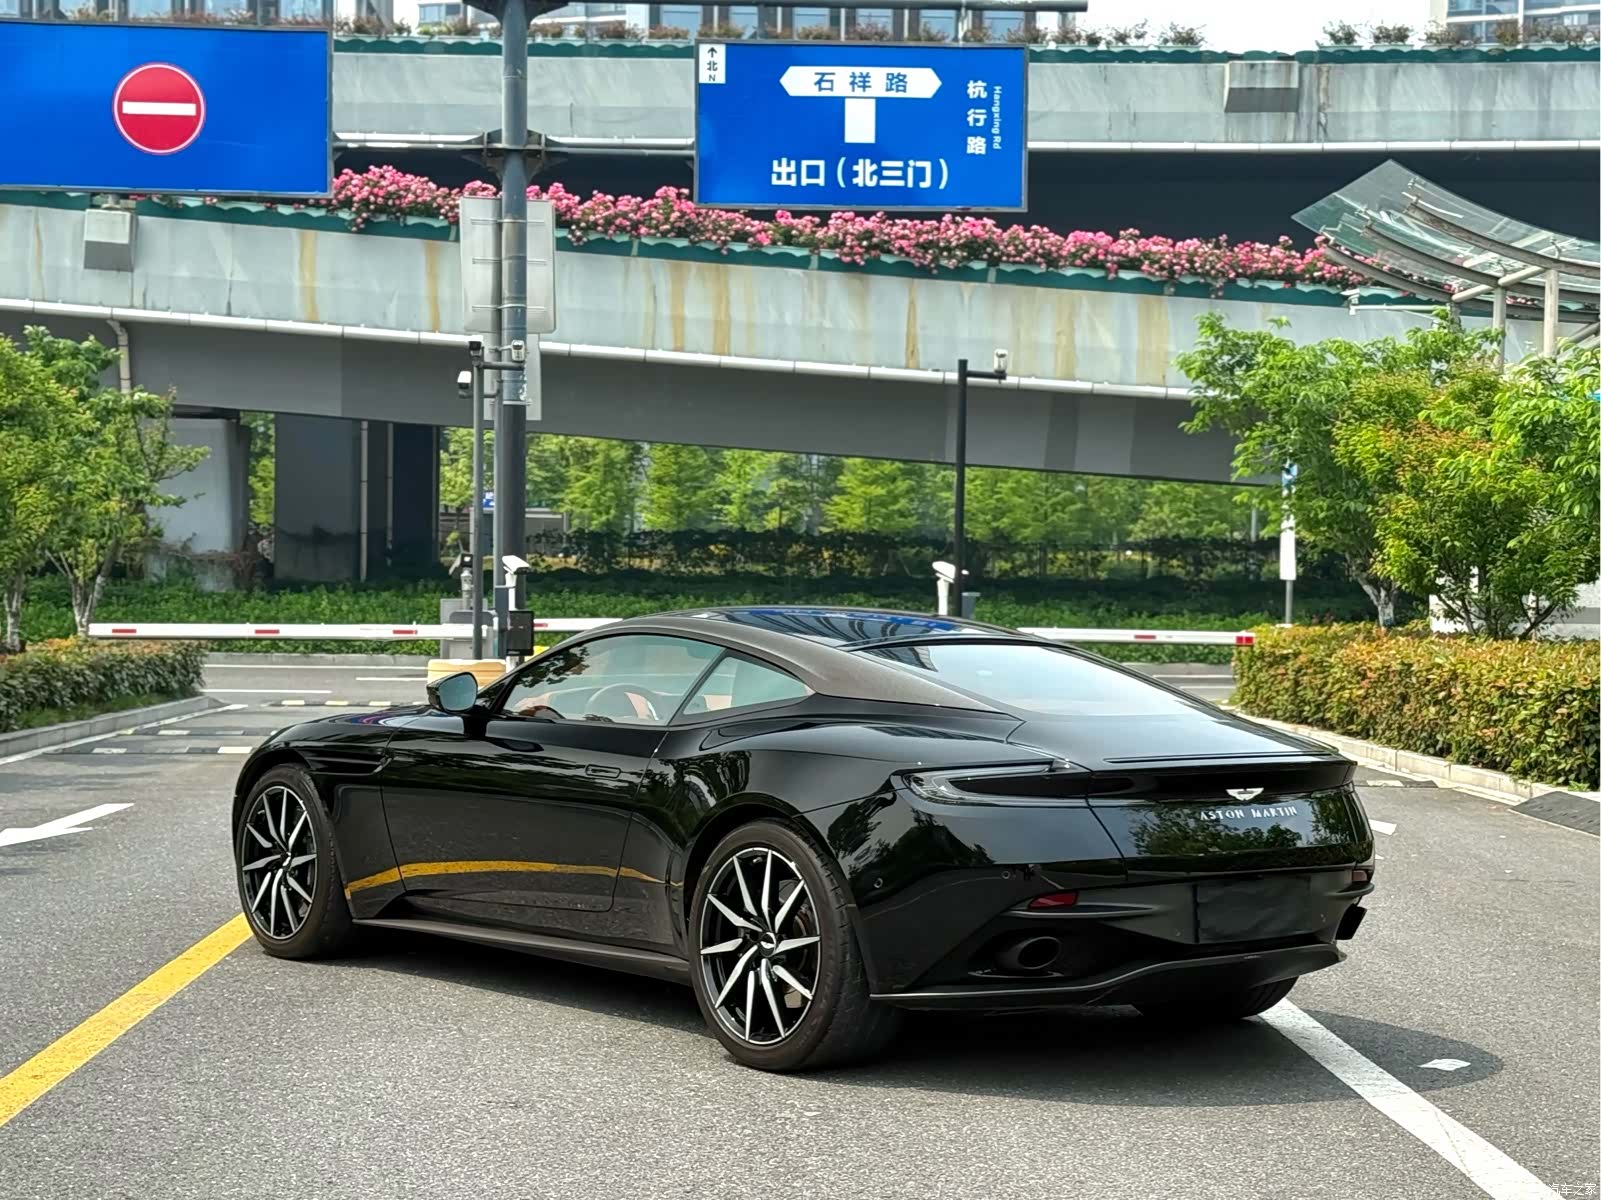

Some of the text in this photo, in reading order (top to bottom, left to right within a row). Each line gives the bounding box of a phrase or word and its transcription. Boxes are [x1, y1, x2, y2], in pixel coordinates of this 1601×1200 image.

[706, 60, 718, 72] 北
[708, 74, 716, 82] N
[813, 71, 908, 93] 石祥路
[966, 80, 988, 155] 杭行路
[991, 85, 1002, 150] Hangxing Rd
[1200, 806, 1297, 820] ASTON MARTIN
